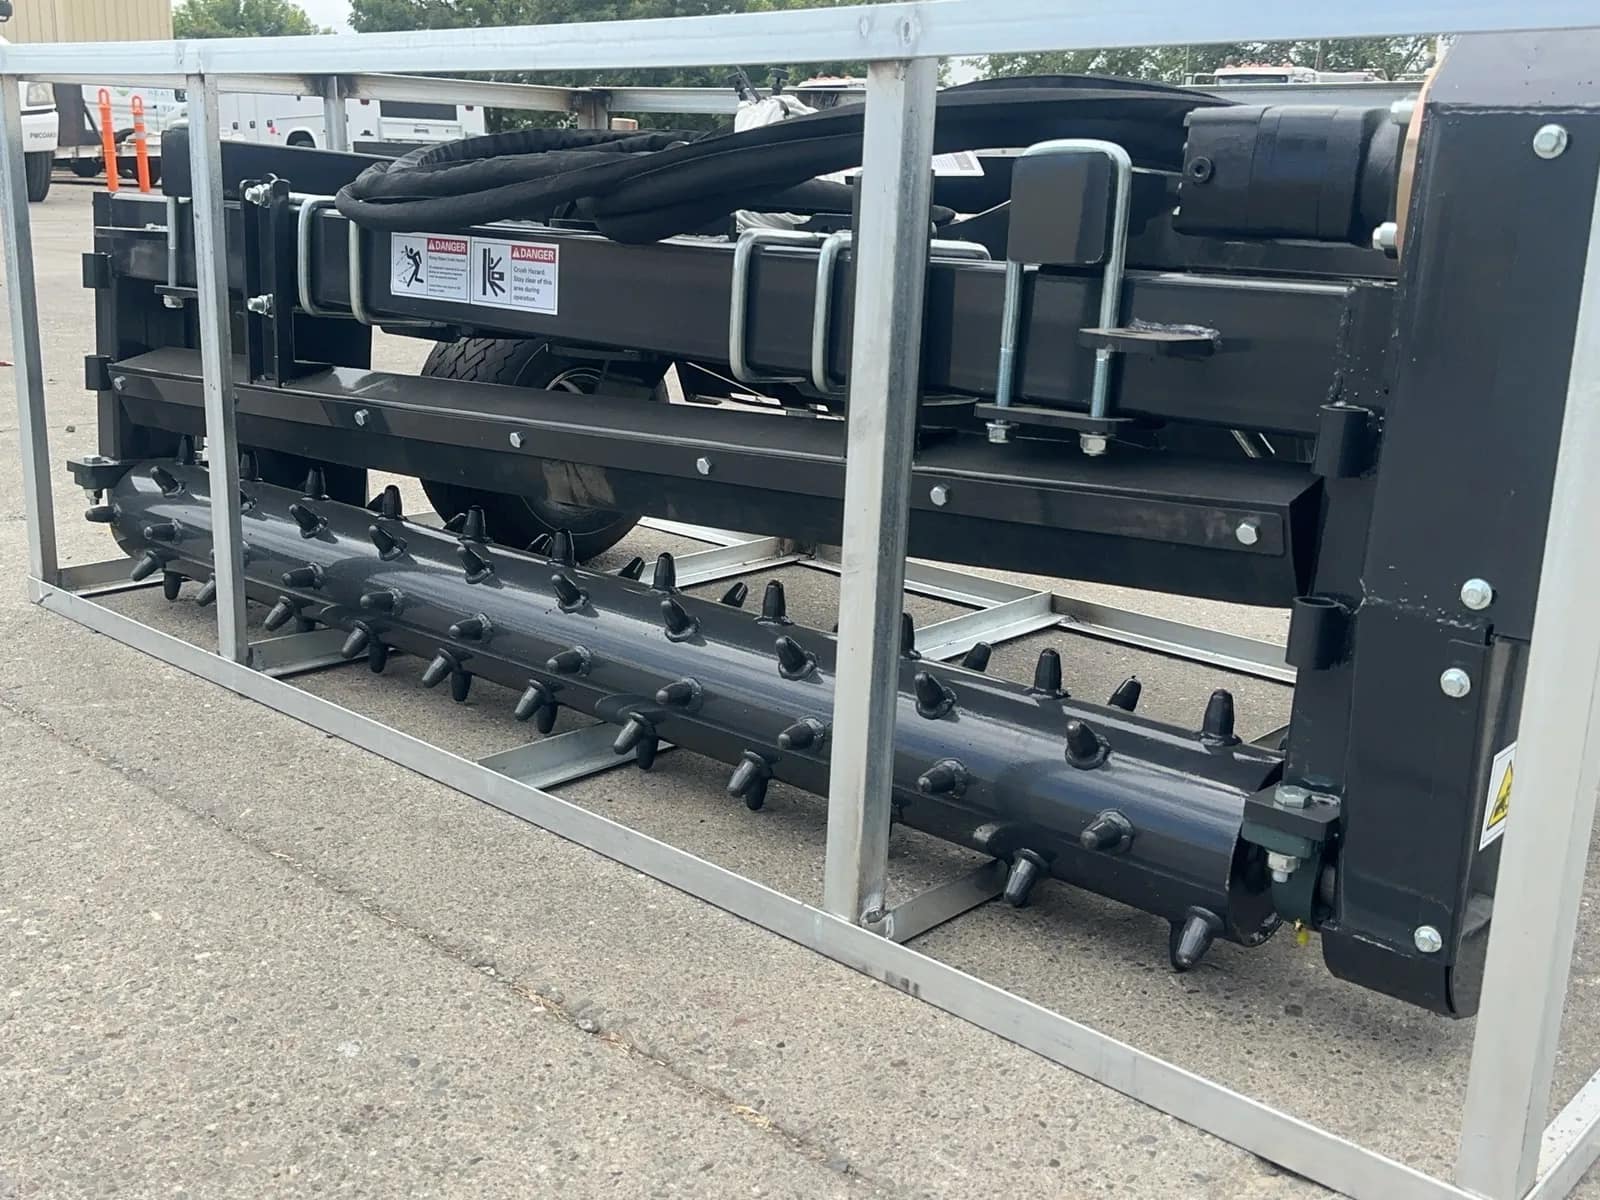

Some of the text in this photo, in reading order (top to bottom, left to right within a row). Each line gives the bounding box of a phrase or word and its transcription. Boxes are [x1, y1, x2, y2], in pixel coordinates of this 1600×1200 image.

[435, 240, 466, 253] DANGER
[520, 249, 555, 261] DANGER
[525, 287, 540, 295] during
